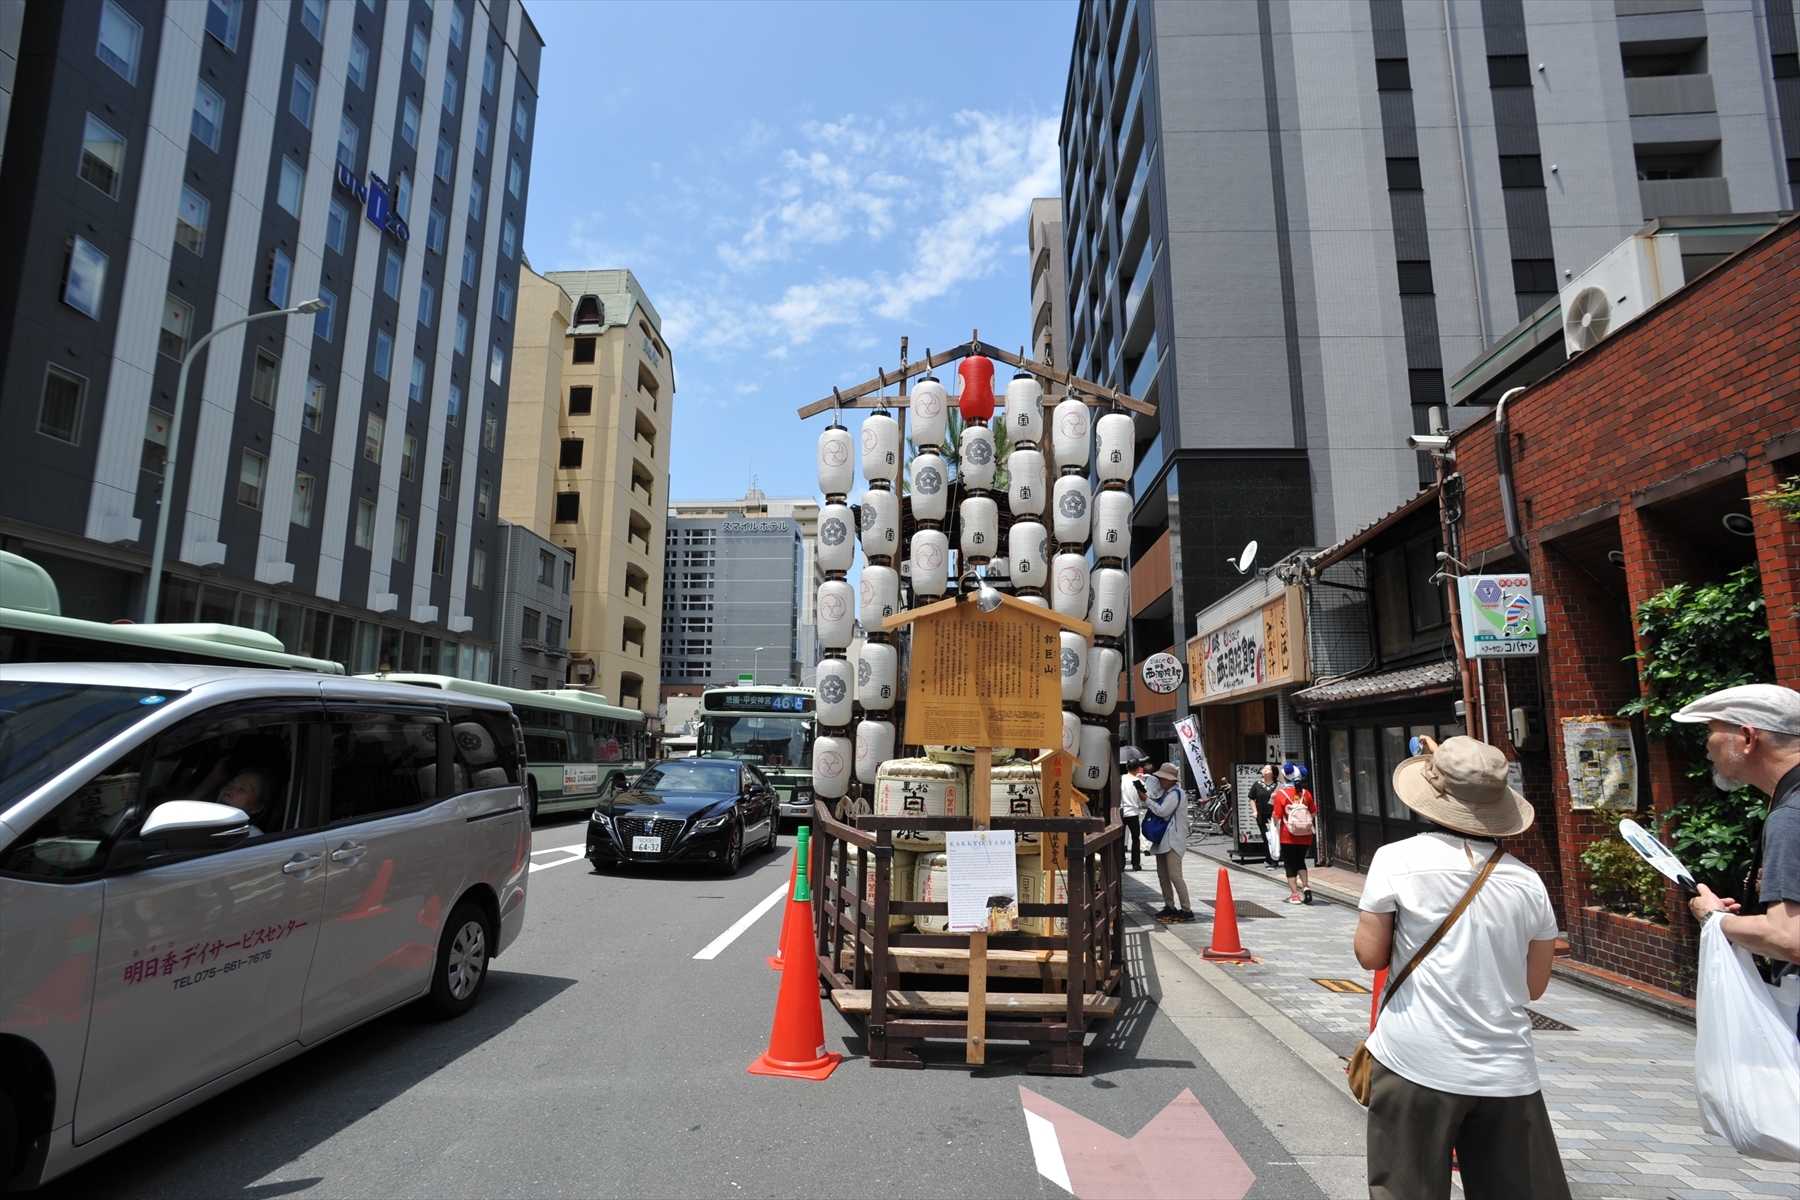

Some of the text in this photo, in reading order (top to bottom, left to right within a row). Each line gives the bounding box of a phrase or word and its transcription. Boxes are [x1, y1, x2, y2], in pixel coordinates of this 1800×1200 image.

[338, 164, 411, 242] UNIZO
[722, 521, 788, 532] スマイルホテル
[1504, 641, 1536, 652] コバヤシ
[1044, 634, 1053, 675] 郭巨山
[773, 697, 790, 709] 46
[1050, 781, 1062, 865] 辰馬本家株式会社
[638, 843, 660, 851] 64-32
[949, 840, 985, 848] KAKKYO
[123, 919, 308, 986] 明日香デイサービスセンター
